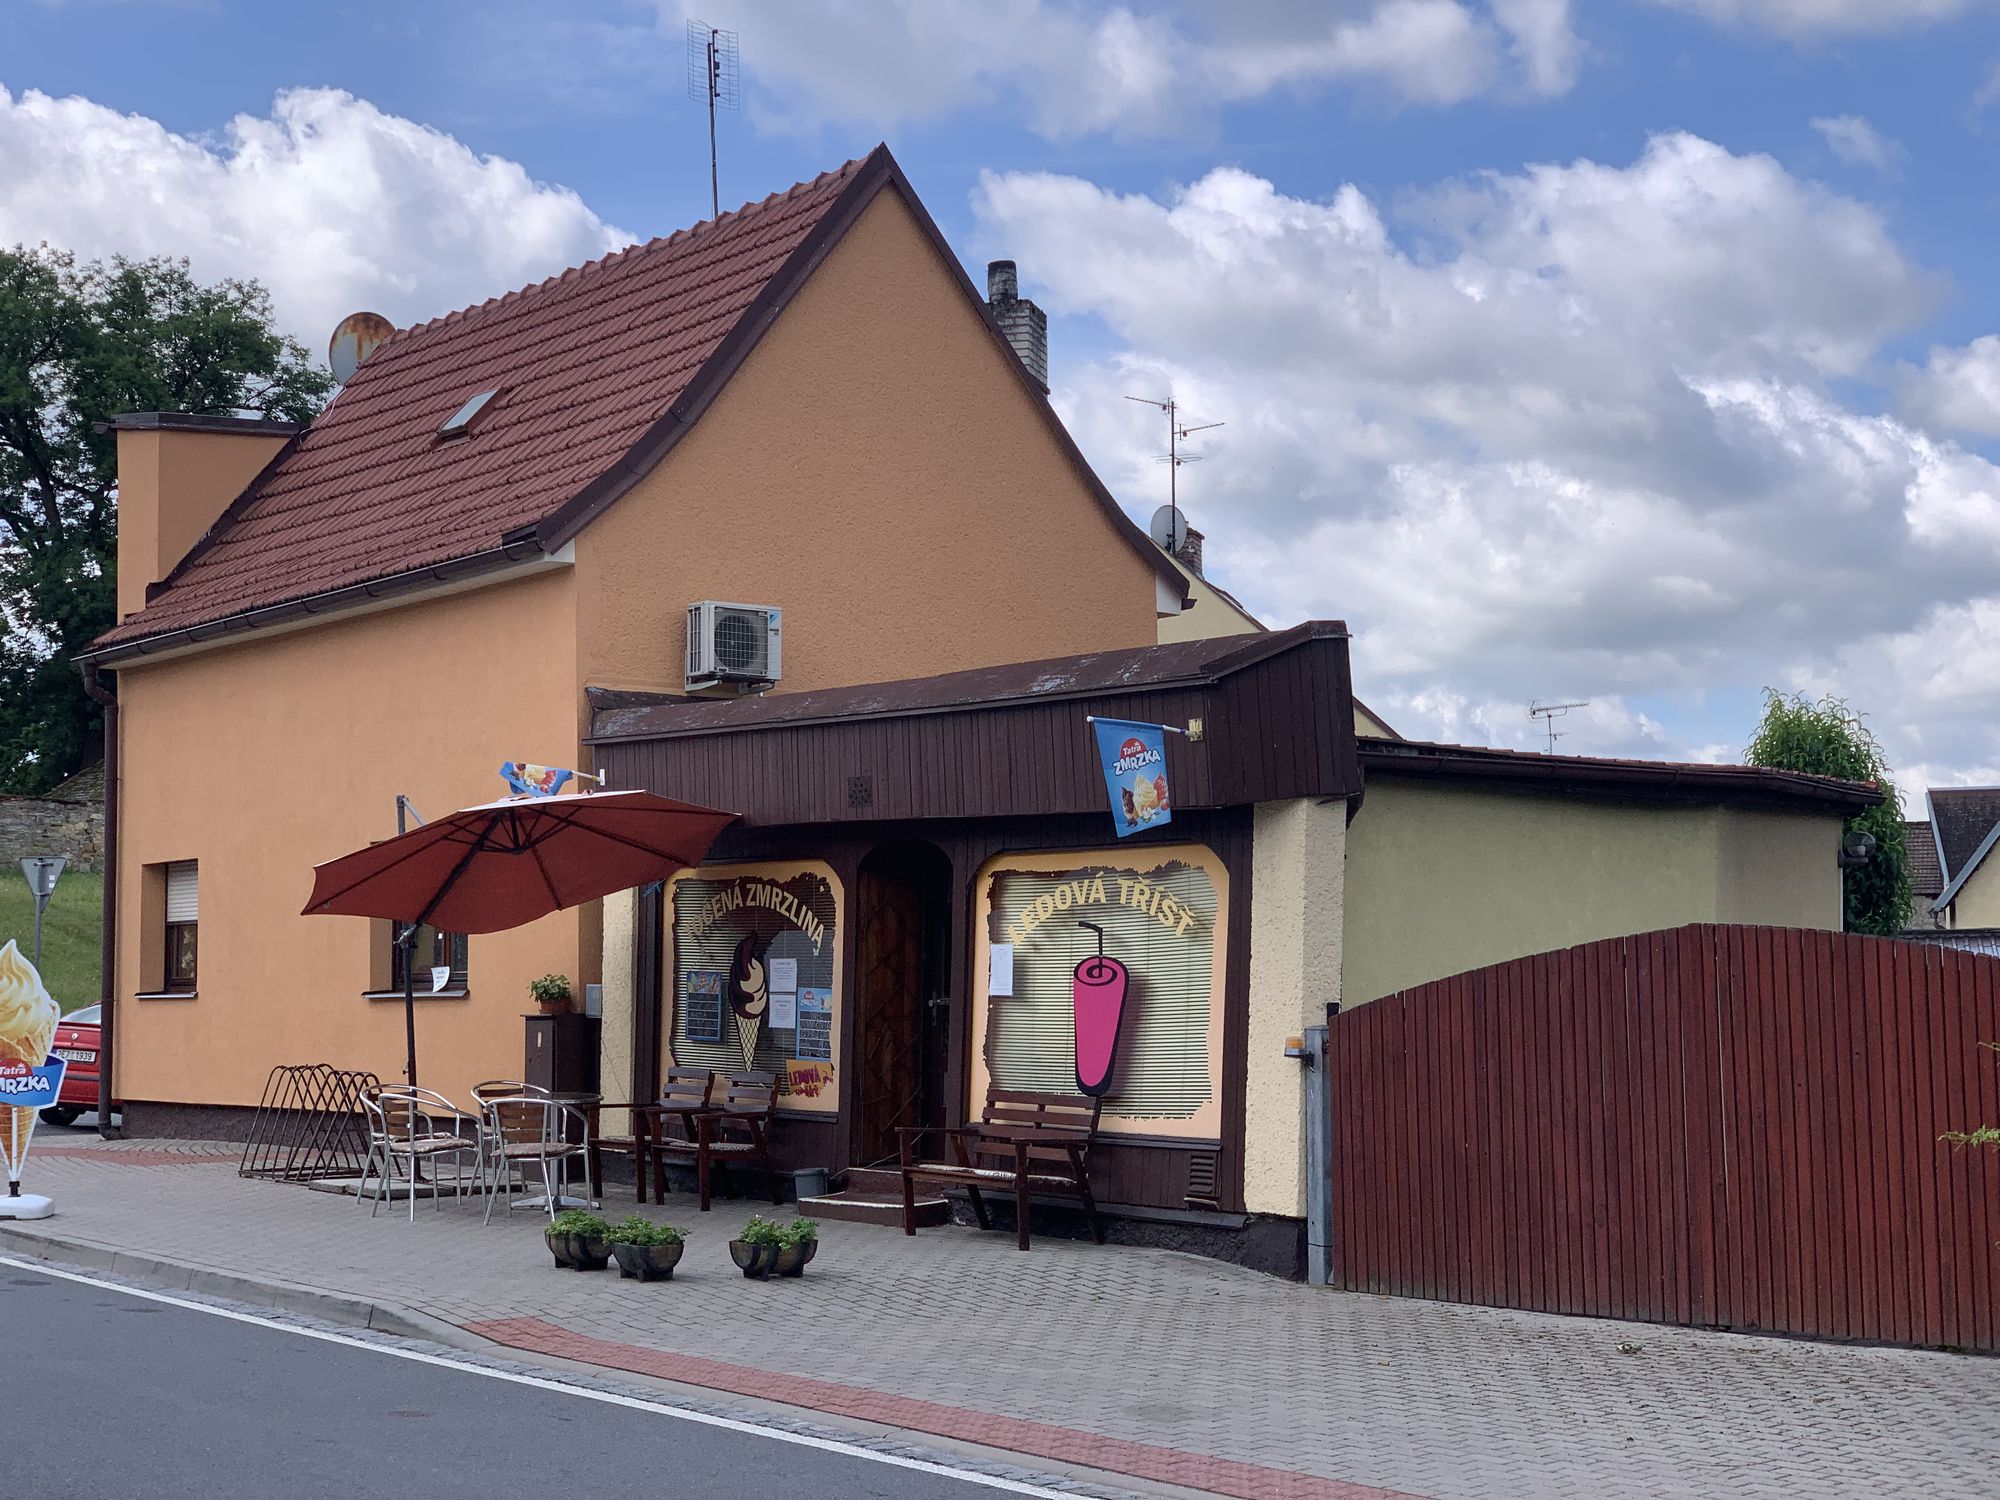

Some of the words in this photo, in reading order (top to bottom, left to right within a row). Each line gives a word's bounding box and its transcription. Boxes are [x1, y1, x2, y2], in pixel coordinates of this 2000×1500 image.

[1122, 744, 1142, 756] Tatra
[1113, 749, 1161, 775] ZMRZKA
[746, 883, 825, 950] ZMRZLINA
[1008, 871, 1107, 945] LEDOVÁ
[76, 1051, 92, 1061] 1939
[0, 1075, 51, 1095] RZKA
